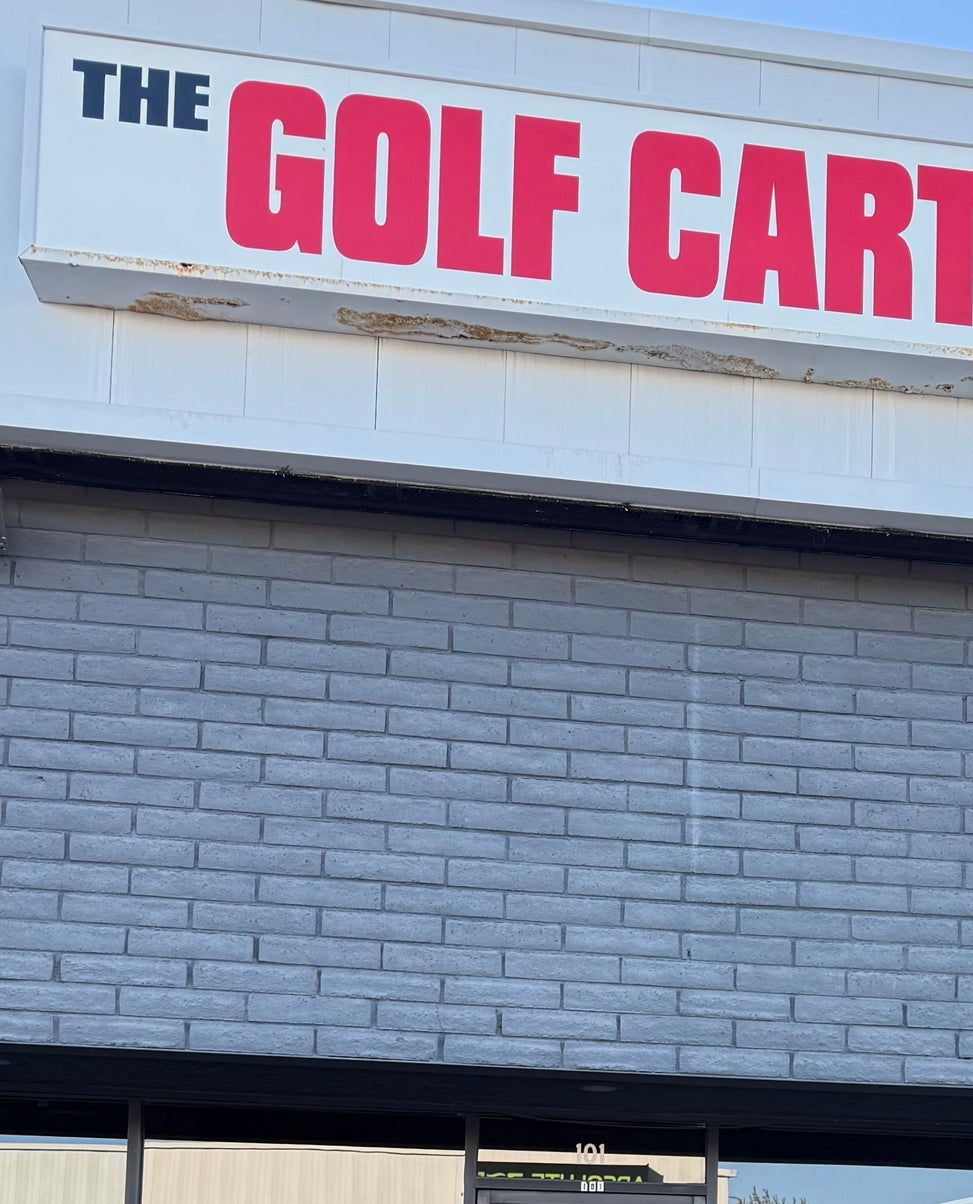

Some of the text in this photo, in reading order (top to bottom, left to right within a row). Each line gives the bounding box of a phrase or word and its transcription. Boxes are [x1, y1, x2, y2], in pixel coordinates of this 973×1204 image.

[73, 58, 210, 132] THE
[226, 80, 581, 281] GOLF
[575, 1143, 605, 1163] 101
